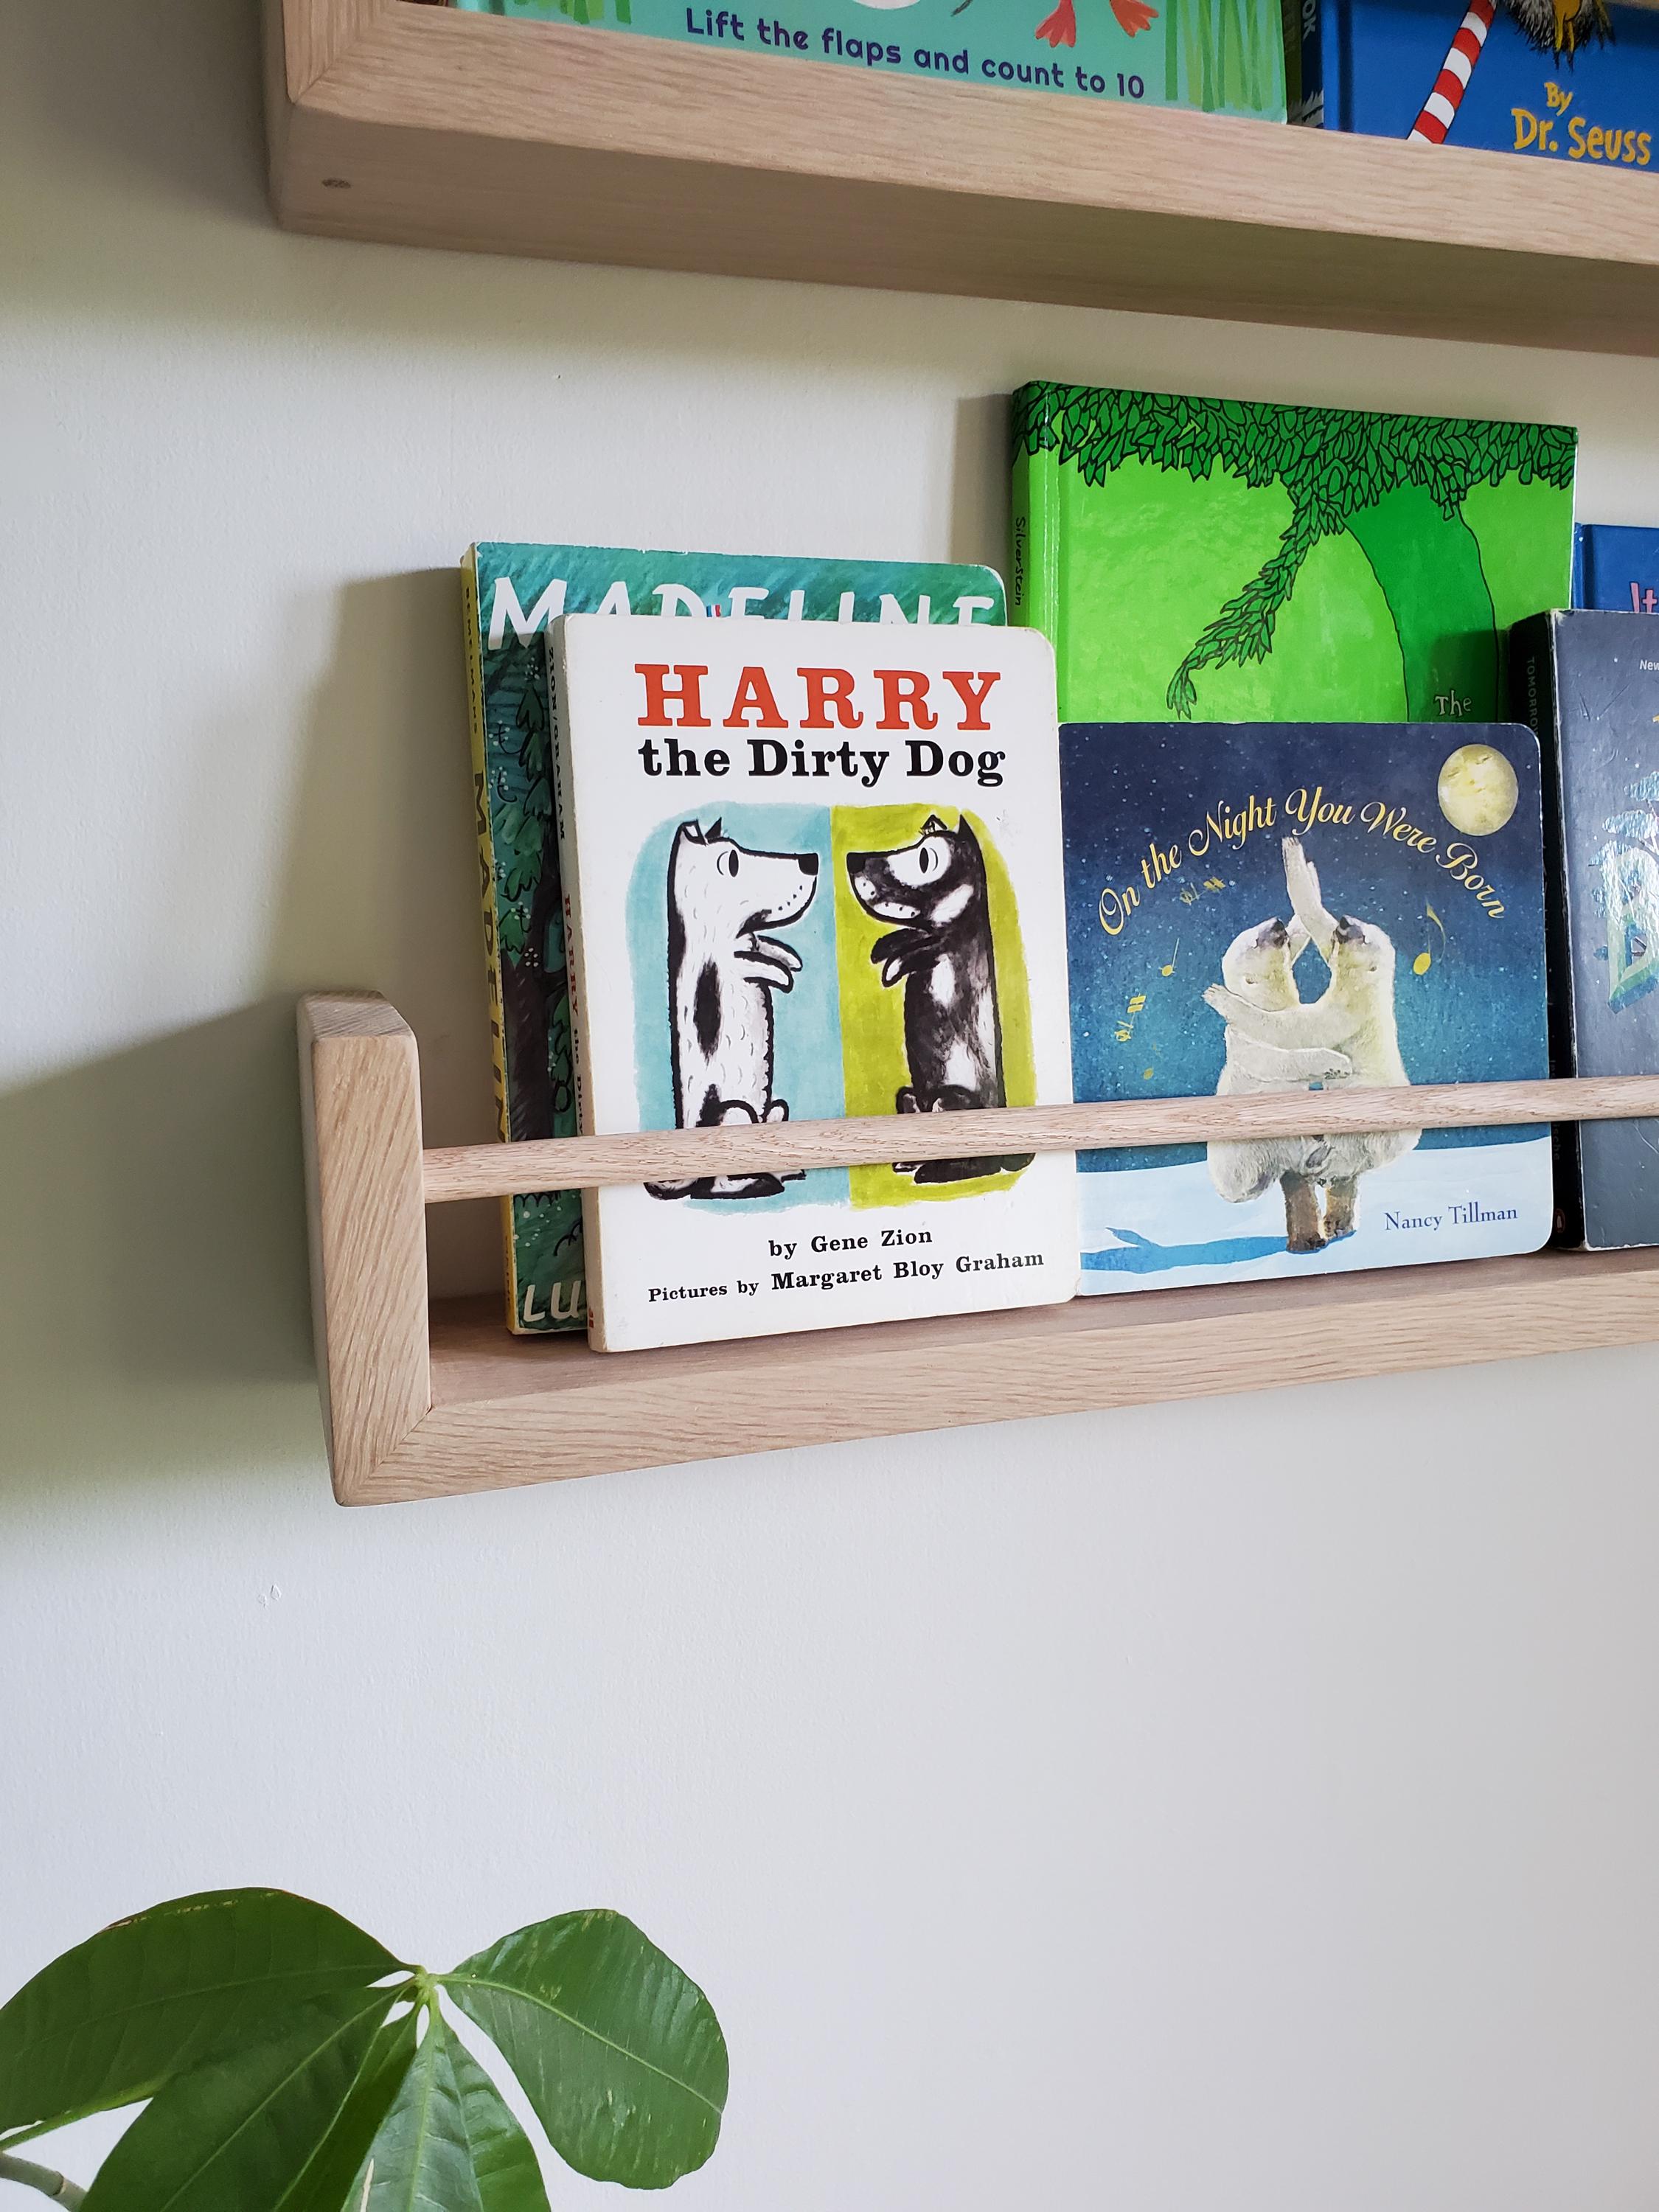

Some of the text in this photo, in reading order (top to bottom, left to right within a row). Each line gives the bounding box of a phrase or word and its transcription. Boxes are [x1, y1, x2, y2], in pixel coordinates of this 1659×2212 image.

[686, 9, 1144, 98] Lift the flaps and count to 10
[1544, 81, 1574, 116] By
[1512, 108, 1652, 166] Dr. Seuss
[1015, 517, 1026, 606] Silverstein
[634, 664, 1001, 731] HARRY
[1434, 689, 1472, 717] The
[637, 737, 1006, 787] the Dirty Dog
[1099, 786, 1504, 936] On the Night You Were Born
[1384, 1201, 1518, 1231] Nancy Tillman
[768, 1228, 933, 1259] by Gene Zion
[647, 1251, 1046, 1304] Pictures by Margaret Bloy Graham
